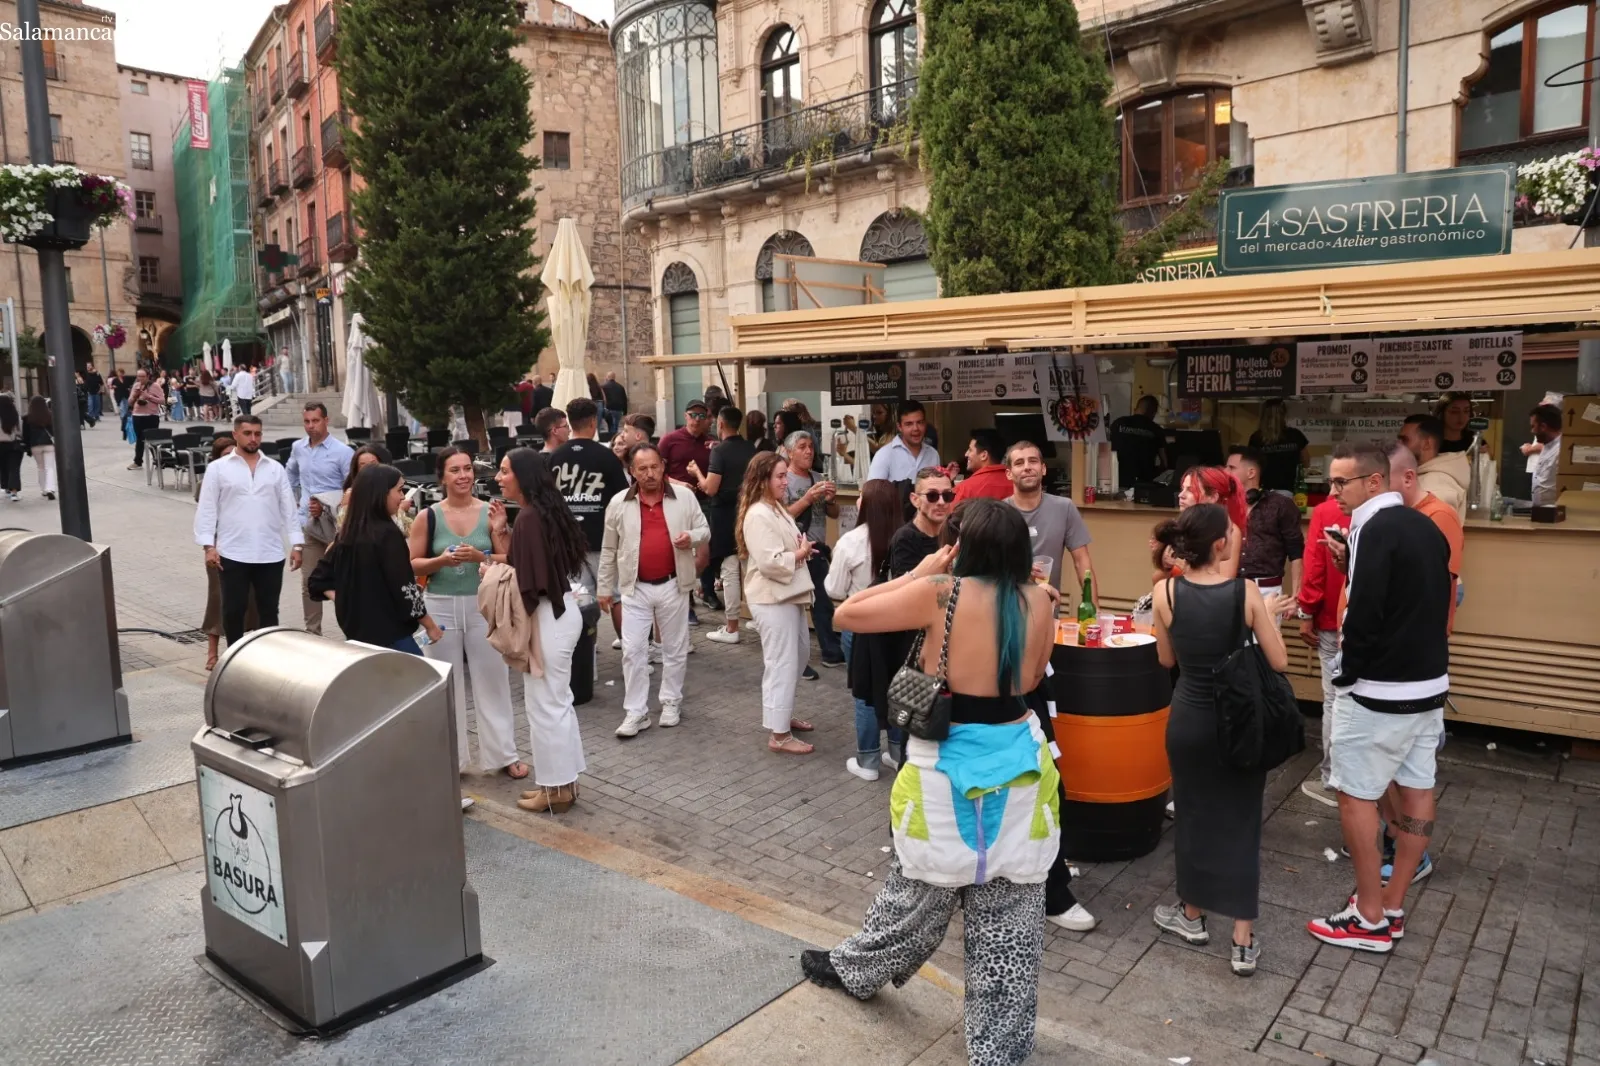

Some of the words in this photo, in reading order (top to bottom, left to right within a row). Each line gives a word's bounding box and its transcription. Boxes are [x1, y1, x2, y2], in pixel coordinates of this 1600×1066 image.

[1236, 209, 1270, 240] LA
[1282, 193, 1488, 237] SASTRERIA
[1240, 243, 1260, 254] del
[1265, 238, 1324, 252] mercado
[1332, 235, 1378, 248] Atelier
[1380, 228, 1485, 247] gastronómico
[1135, 261, 1217, 284] ASTRERIA
[1380, 342, 1412, 352] PINCHOS
[1422, 340, 1452, 351] SASTRE
[1469, 336, 1513, 349] BOTELLAS
[1187, 355, 1231, 373] PINCHO
[1236, 358, 1268, 368] Mollete
[835, 371, 864, 385] PINCHO
[1236, 368, 1247, 378] de
[1248, 368, 1282, 378] Secreto
[875, 381, 898, 390] Secreto
[1196, 374, 1231, 392] FERIA
[842, 386, 864, 400] FERIA
[213, 856, 278, 908] BASURA
